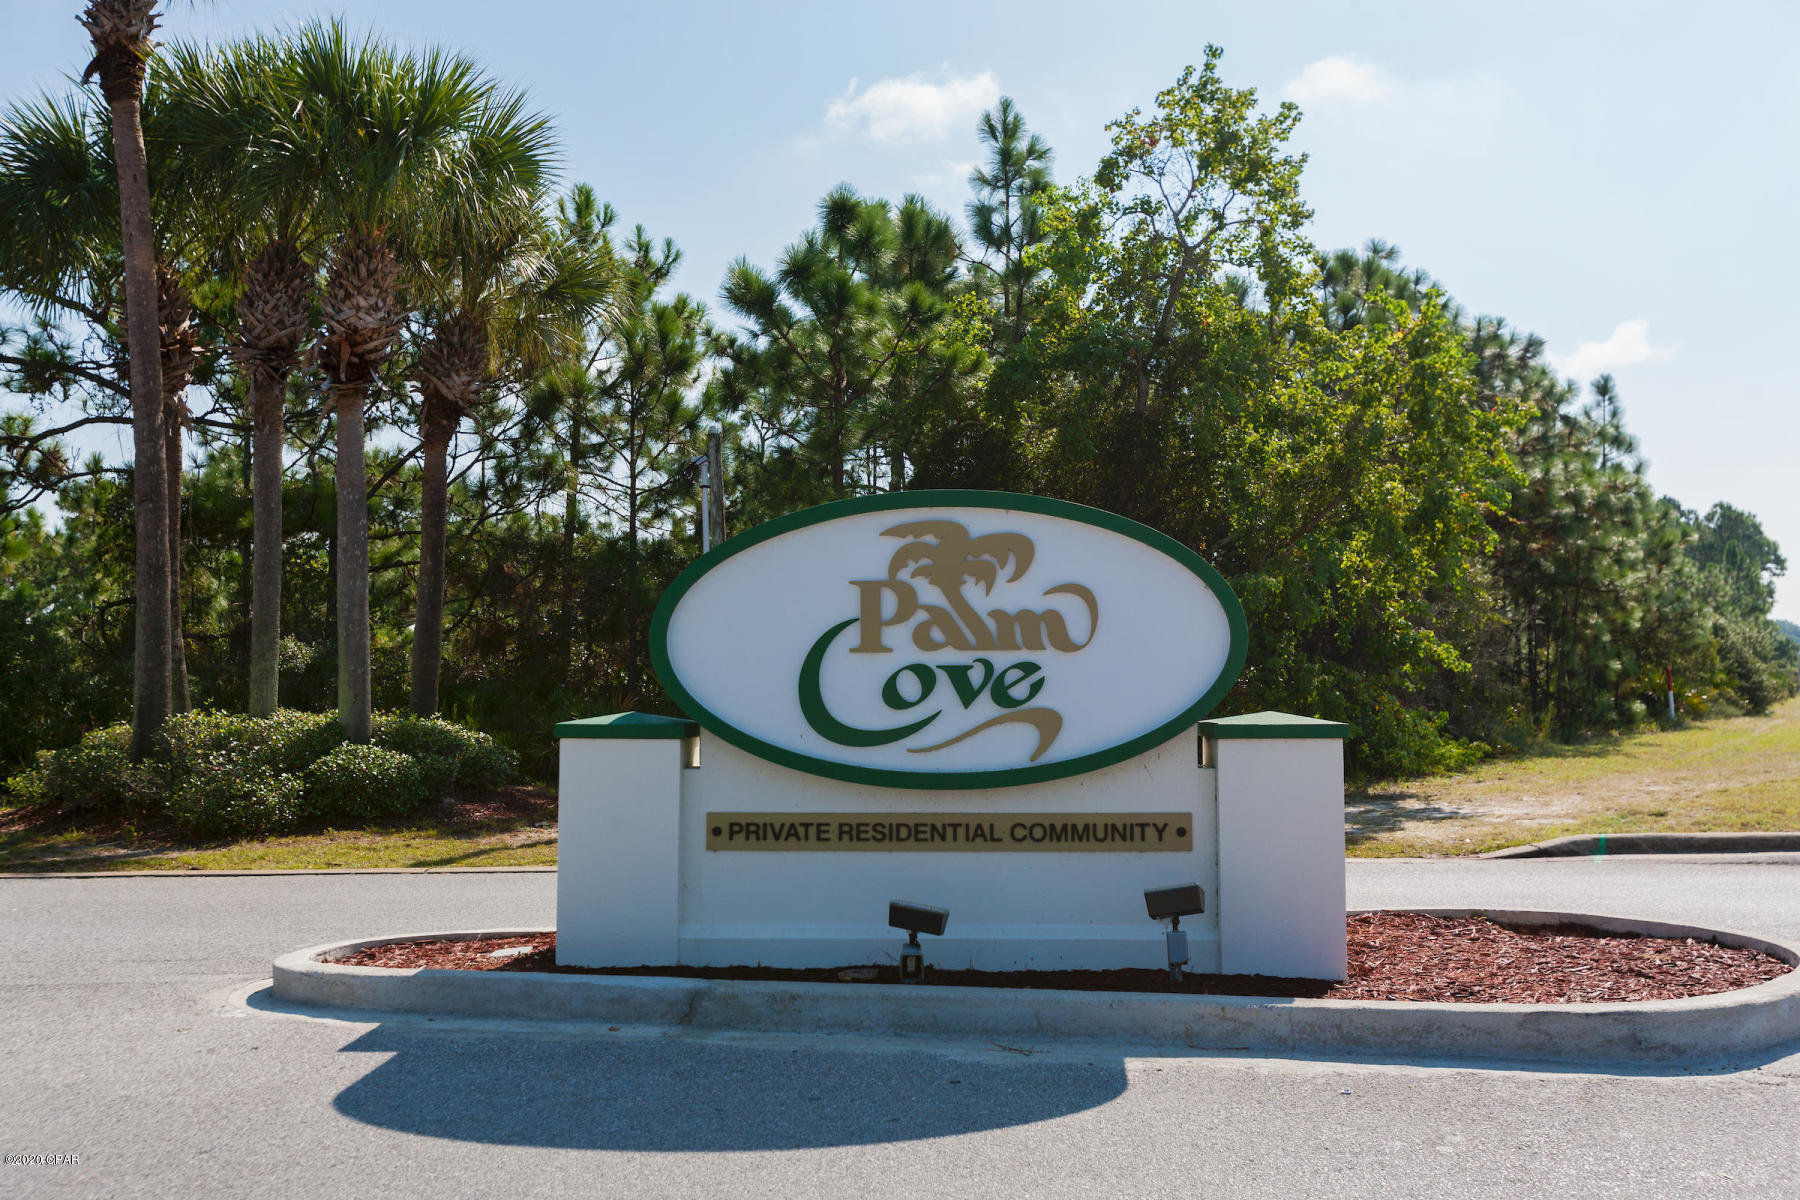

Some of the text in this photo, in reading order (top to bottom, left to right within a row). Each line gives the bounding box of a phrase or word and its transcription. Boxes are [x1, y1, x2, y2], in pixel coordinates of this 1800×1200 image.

[848, 570, 1099, 653] Palm
[798, 618, 1045, 748] Cove
[728, 822, 1169, 843] PRIVATE RESIDENTIAL COMMUNITY
